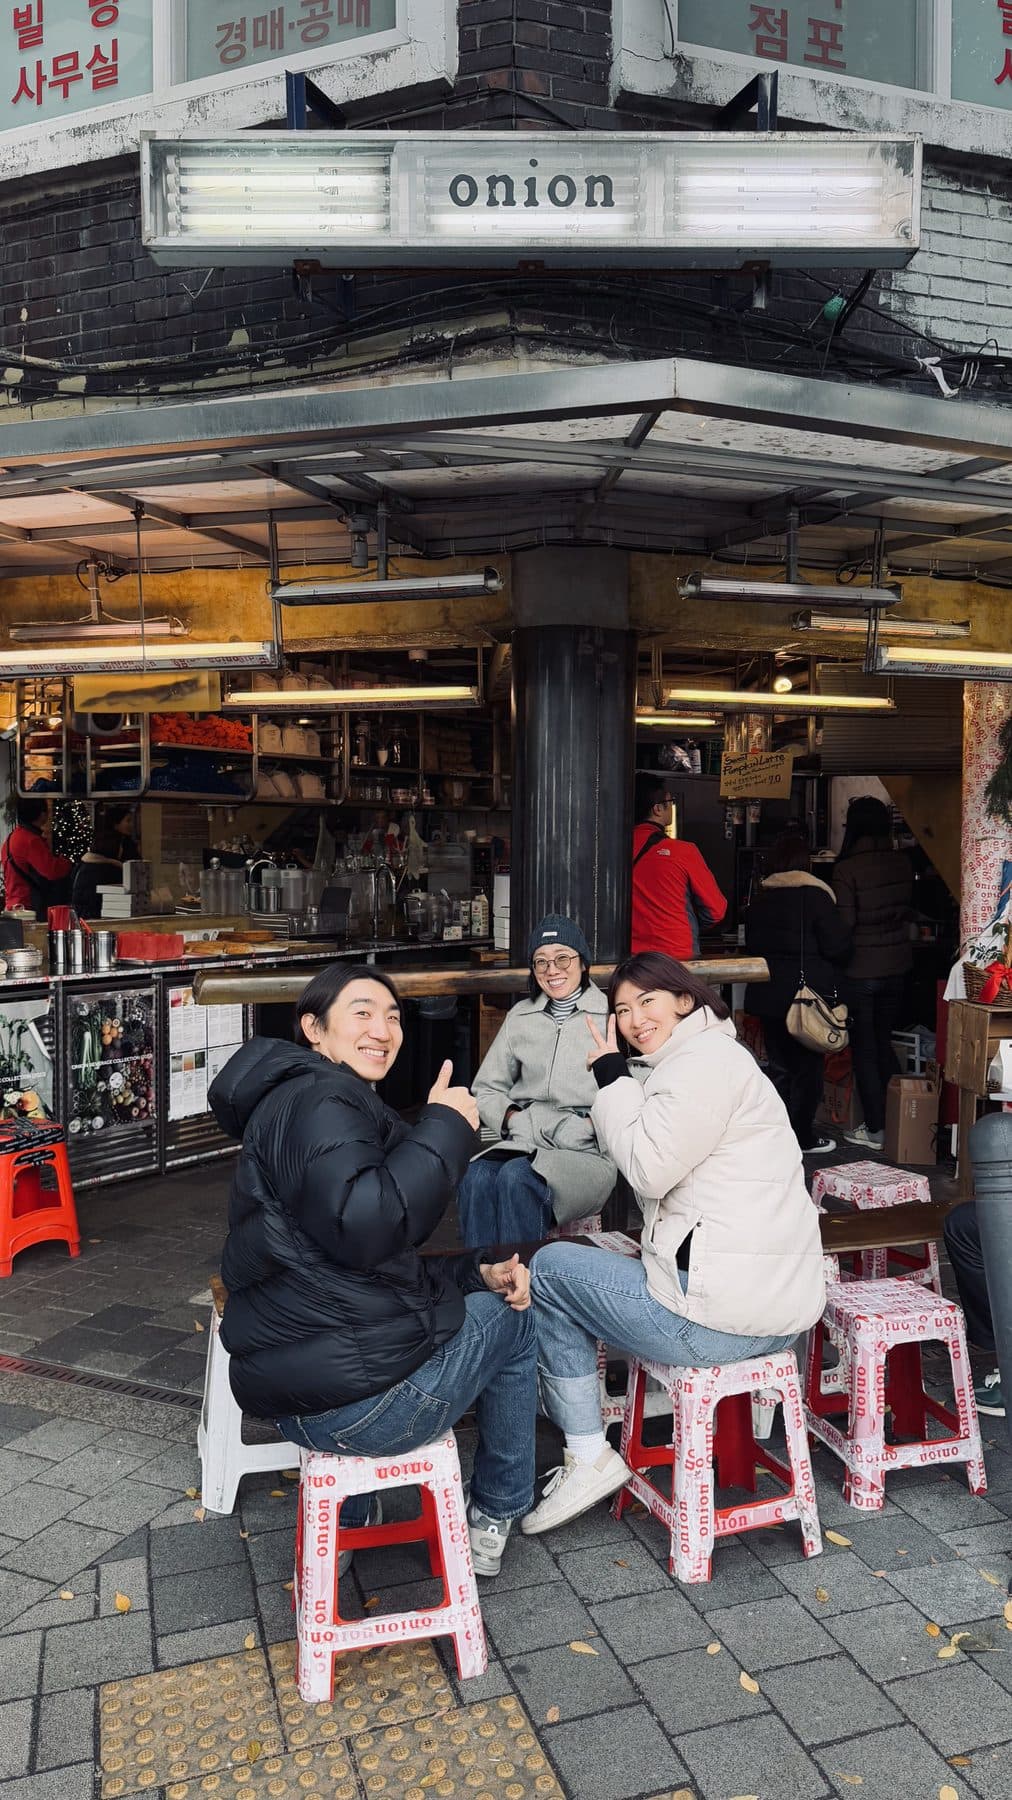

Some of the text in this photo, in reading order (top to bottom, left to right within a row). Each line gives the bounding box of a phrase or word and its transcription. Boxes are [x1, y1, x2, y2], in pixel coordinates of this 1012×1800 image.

[11, 38, 119, 105] 사무실
[449, 158, 615, 207] onion
[113, 1055, 140, 1063] COLLECTION
[376, 1460, 433, 1480] onion
[919, 1446, 960, 1462] onion
[314, 1499, 330, 1557] onion
[679, 1501, 690, 1553] onion
[697, 1484, 709, 1536] onion
[375, 1616, 432, 1635] onion
